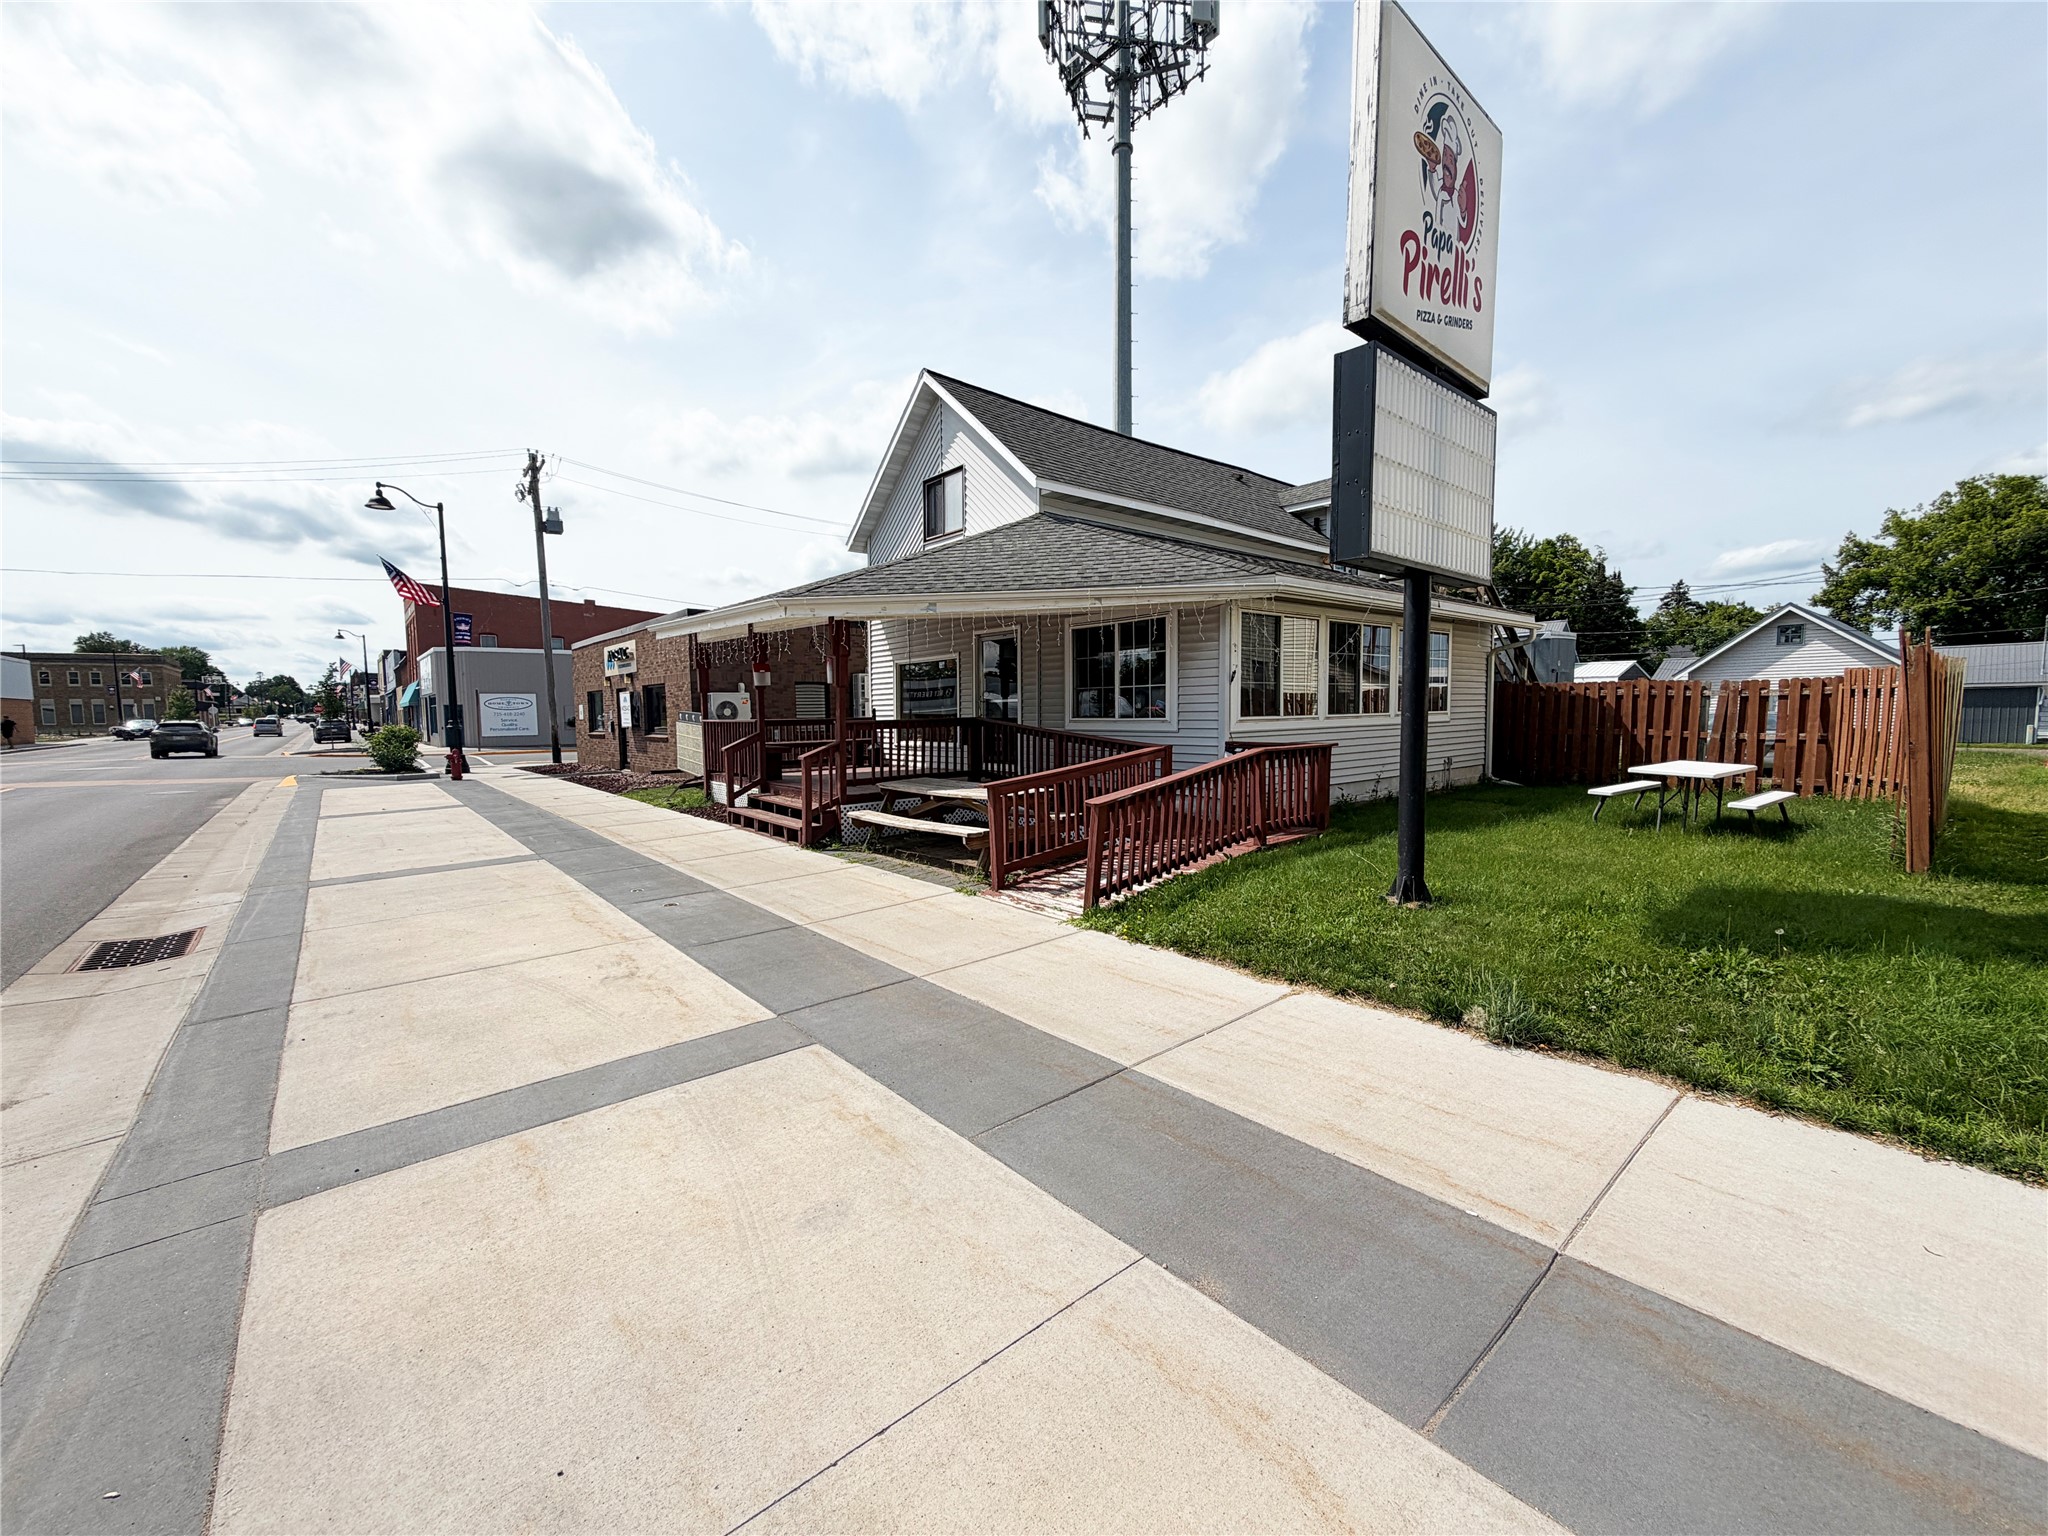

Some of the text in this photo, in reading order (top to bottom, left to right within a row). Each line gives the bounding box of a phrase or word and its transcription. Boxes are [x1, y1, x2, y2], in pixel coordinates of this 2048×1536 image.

[1414, 75, 1484, 254] DINE IN TAKE OUT DELIVERY
[1422, 210, 1454, 263] Papa
[1400, 229, 1483, 313] Pirelli's
[1416, 309, 1473, 330] PIZZA & GRINDERS
